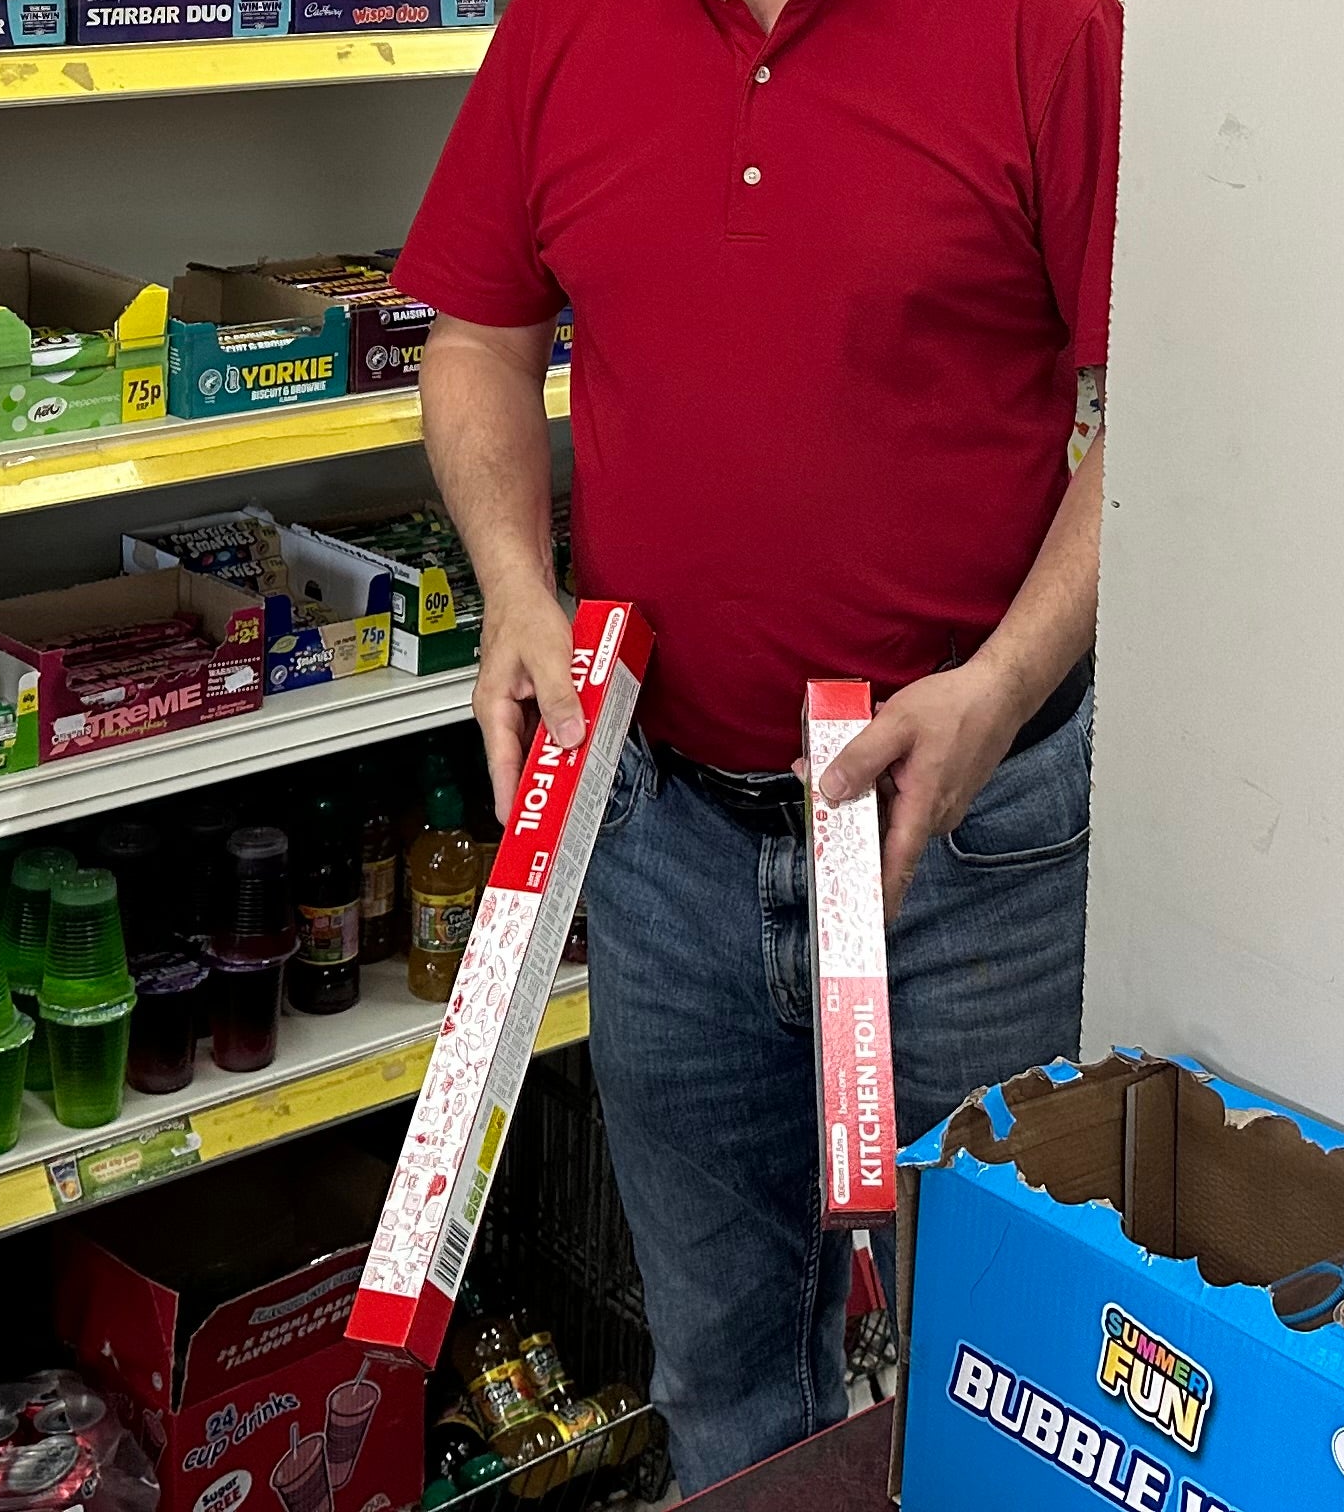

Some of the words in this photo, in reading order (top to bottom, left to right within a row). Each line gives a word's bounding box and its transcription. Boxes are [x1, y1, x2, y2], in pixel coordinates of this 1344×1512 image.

[20, 11, 60, 22] WIN-WIN
[86, 5, 180, 27] STARBAR
[187, 4, 232, 23] DUO
[238, 1, 282, 11] WIN-WIN
[304, 3, 343, 18] Cadbury
[352, 7, 394, 25] Wispa
[396, 4, 429, 23] duo
[393, 309, 425, 322] RAISIN
[241, 356, 333, 389] YORKIE
[68, 393, 120, 410] peppermint
[128, 380, 161, 405] 75p
[251, 388, 281, 401] BISCUIT
[291, 382, 327, 397] BROWNIE
[136, 402, 149, 411] RRP
[189, 529, 256, 558] SMARTIES
[425, 592, 449, 612] 60p
[236, 618, 260, 629] Pack
[228, 635, 238, 643] of
[239, 629, 260, 644] 24
[361, 627, 385, 644] 75p
[295, 647, 334, 670] SMARTIES
[514, 772, 555, 837] FOIL
[853, 997, 877, 1059] FOIL
[856, 1065, 884, 1187] KITCHEN
[225, 1333, 294, 1370] FLAVOUR
[297, 1318, 328, 1338] CUP
[1106, 1306, 1208, 1400] SUMMER
[1102, 1341, 1204, 1444] FUN
[183, 1437, 229, 1472] cup
[233, 1393, 301, 1444] drinks
[207, 1403, 238, 1442] 24
[956, 1351, 1166, 1512] BUBBLE
[201, 1475, 239, 1508] Sugar
